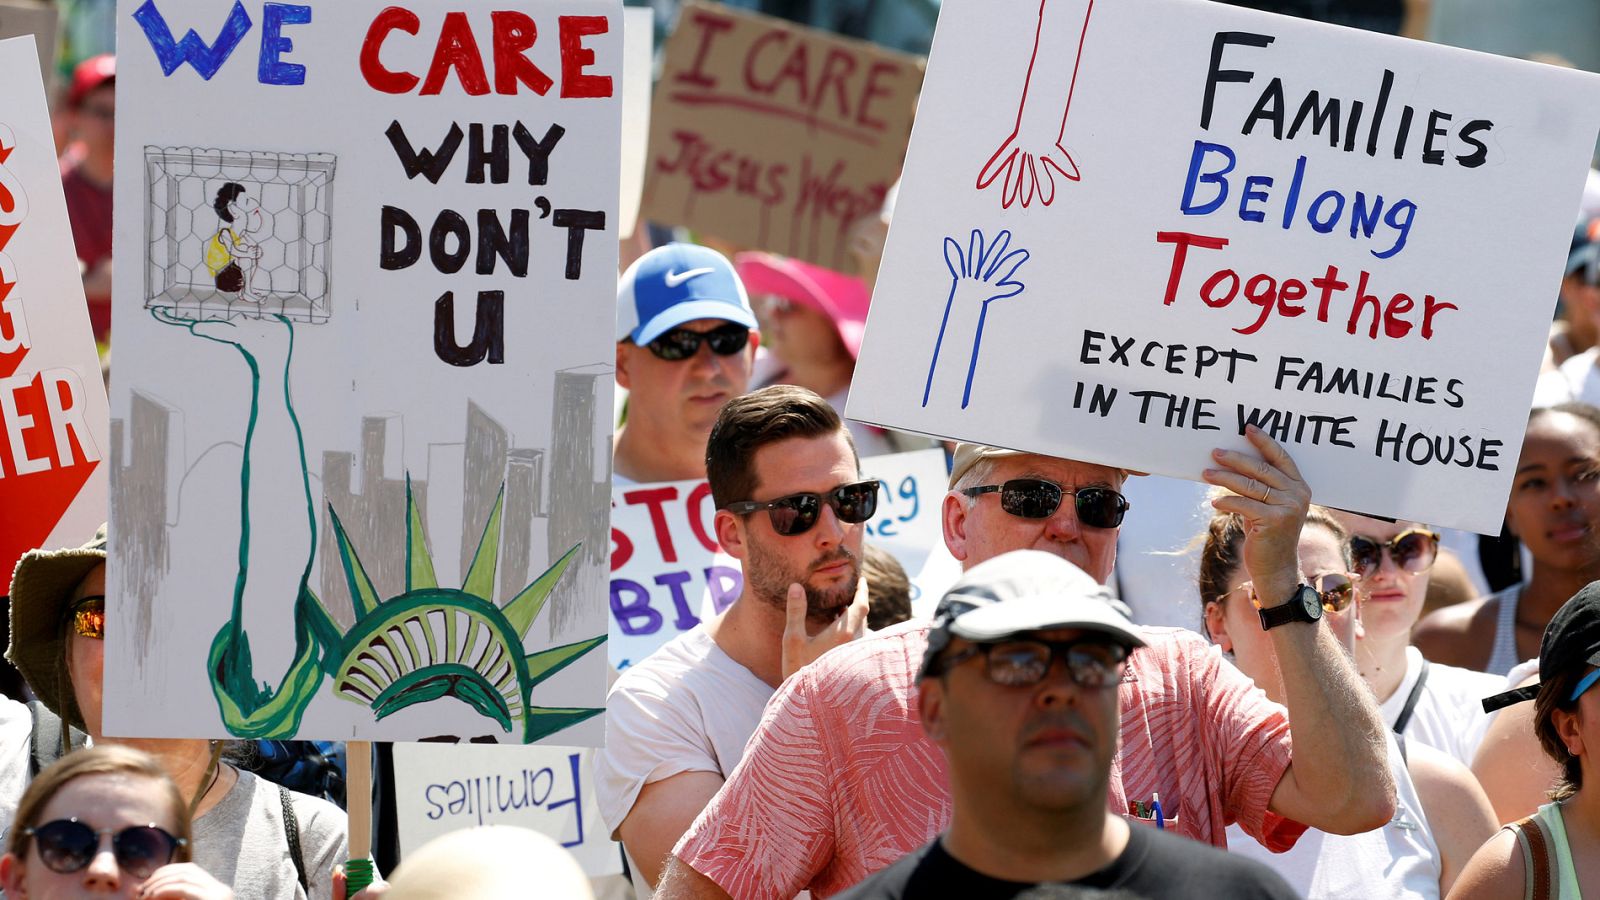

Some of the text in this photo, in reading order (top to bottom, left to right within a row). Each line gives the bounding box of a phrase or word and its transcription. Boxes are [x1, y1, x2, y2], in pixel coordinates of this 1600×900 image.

[131, 0, 613, 98] WE CARE
[670, 14, 900, 131] I CARE
[384, 119, 566, 185] WHY
[379, 196, 606, 280] DON'T
[432, 289, 505, 367] U
[1156, 231, 1458, 341] Together
[1079, 329, 1466, 408] EXCEPT FAMILIES
[1072, 381, 1505, 471] IN THE WHITE HOUSE
